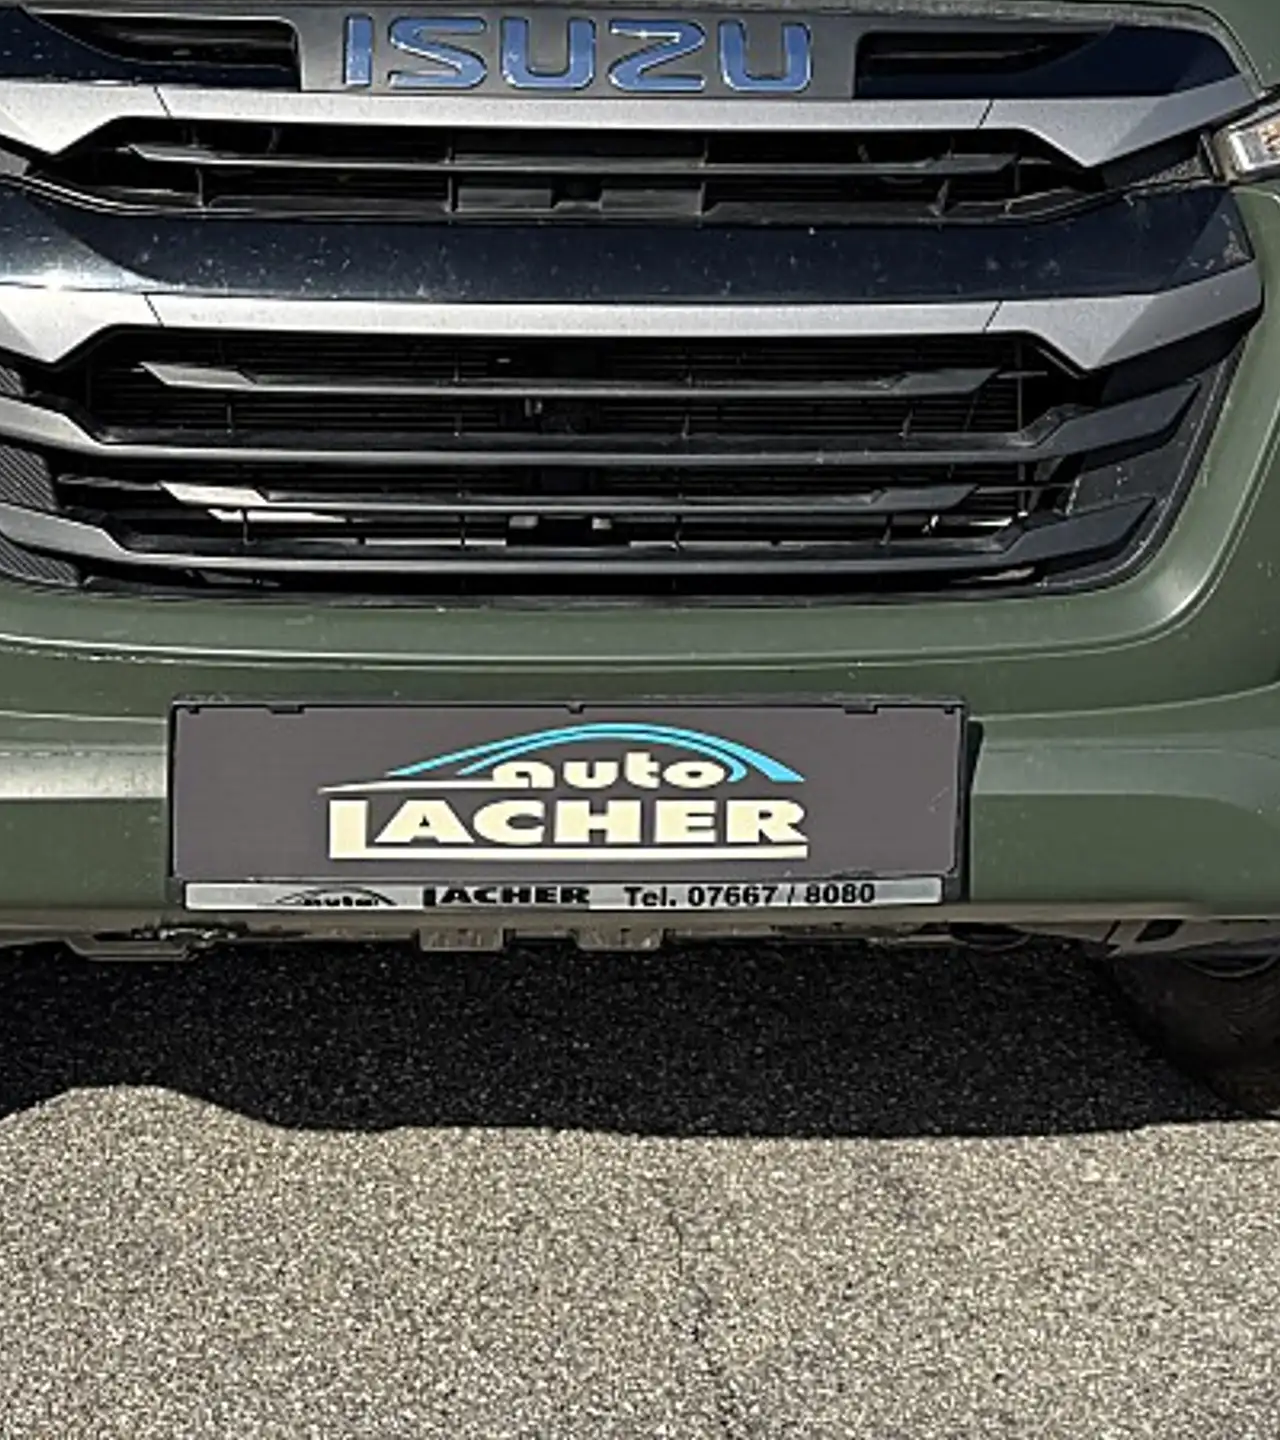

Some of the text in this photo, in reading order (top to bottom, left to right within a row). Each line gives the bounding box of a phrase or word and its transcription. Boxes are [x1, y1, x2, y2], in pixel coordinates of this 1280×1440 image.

[343, 13, 813, 93] ISUZU
[492, 752, 726, 789] auto
[329, 799, 809, 859] LACHER
[422, 885, 591, 908] LACHER
[624, 886, 677, 908] Tel.
[686, 885, 778, 907] 07667
[803, 883, 876, 905] 8080
